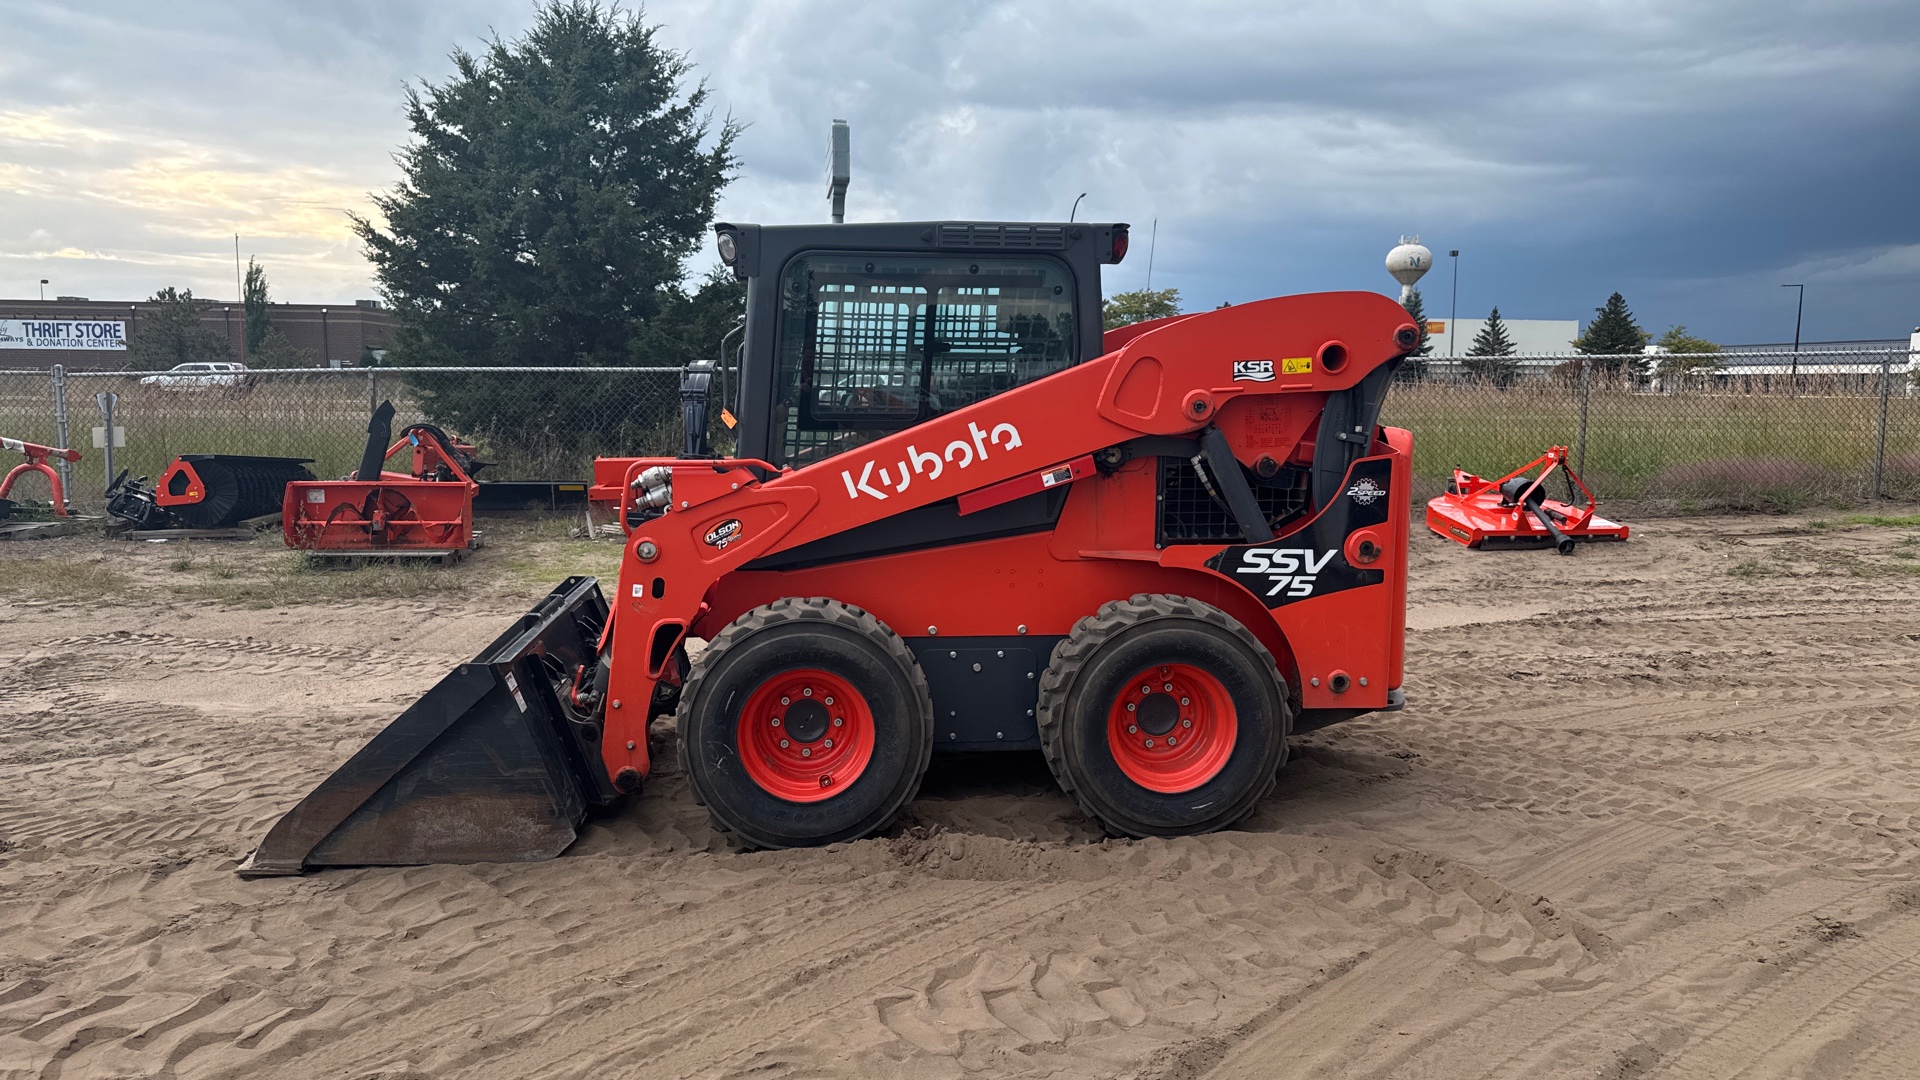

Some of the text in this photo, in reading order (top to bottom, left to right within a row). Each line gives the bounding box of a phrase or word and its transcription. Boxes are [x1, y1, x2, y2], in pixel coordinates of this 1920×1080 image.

[22, 322, 122, 339] THRIFT STORE
[26, 337, 122, 348] & DONATION CENTER
[1233, 360, 1274, 373] KSR
[841, 421, 1023, 501] Kubota
[706, 520, 739, 542] OLSON
[715, 537, 728, 550] 75
[1236, 548, 1339, 574] SSV
[1265, 575, 1317, 597] 75
